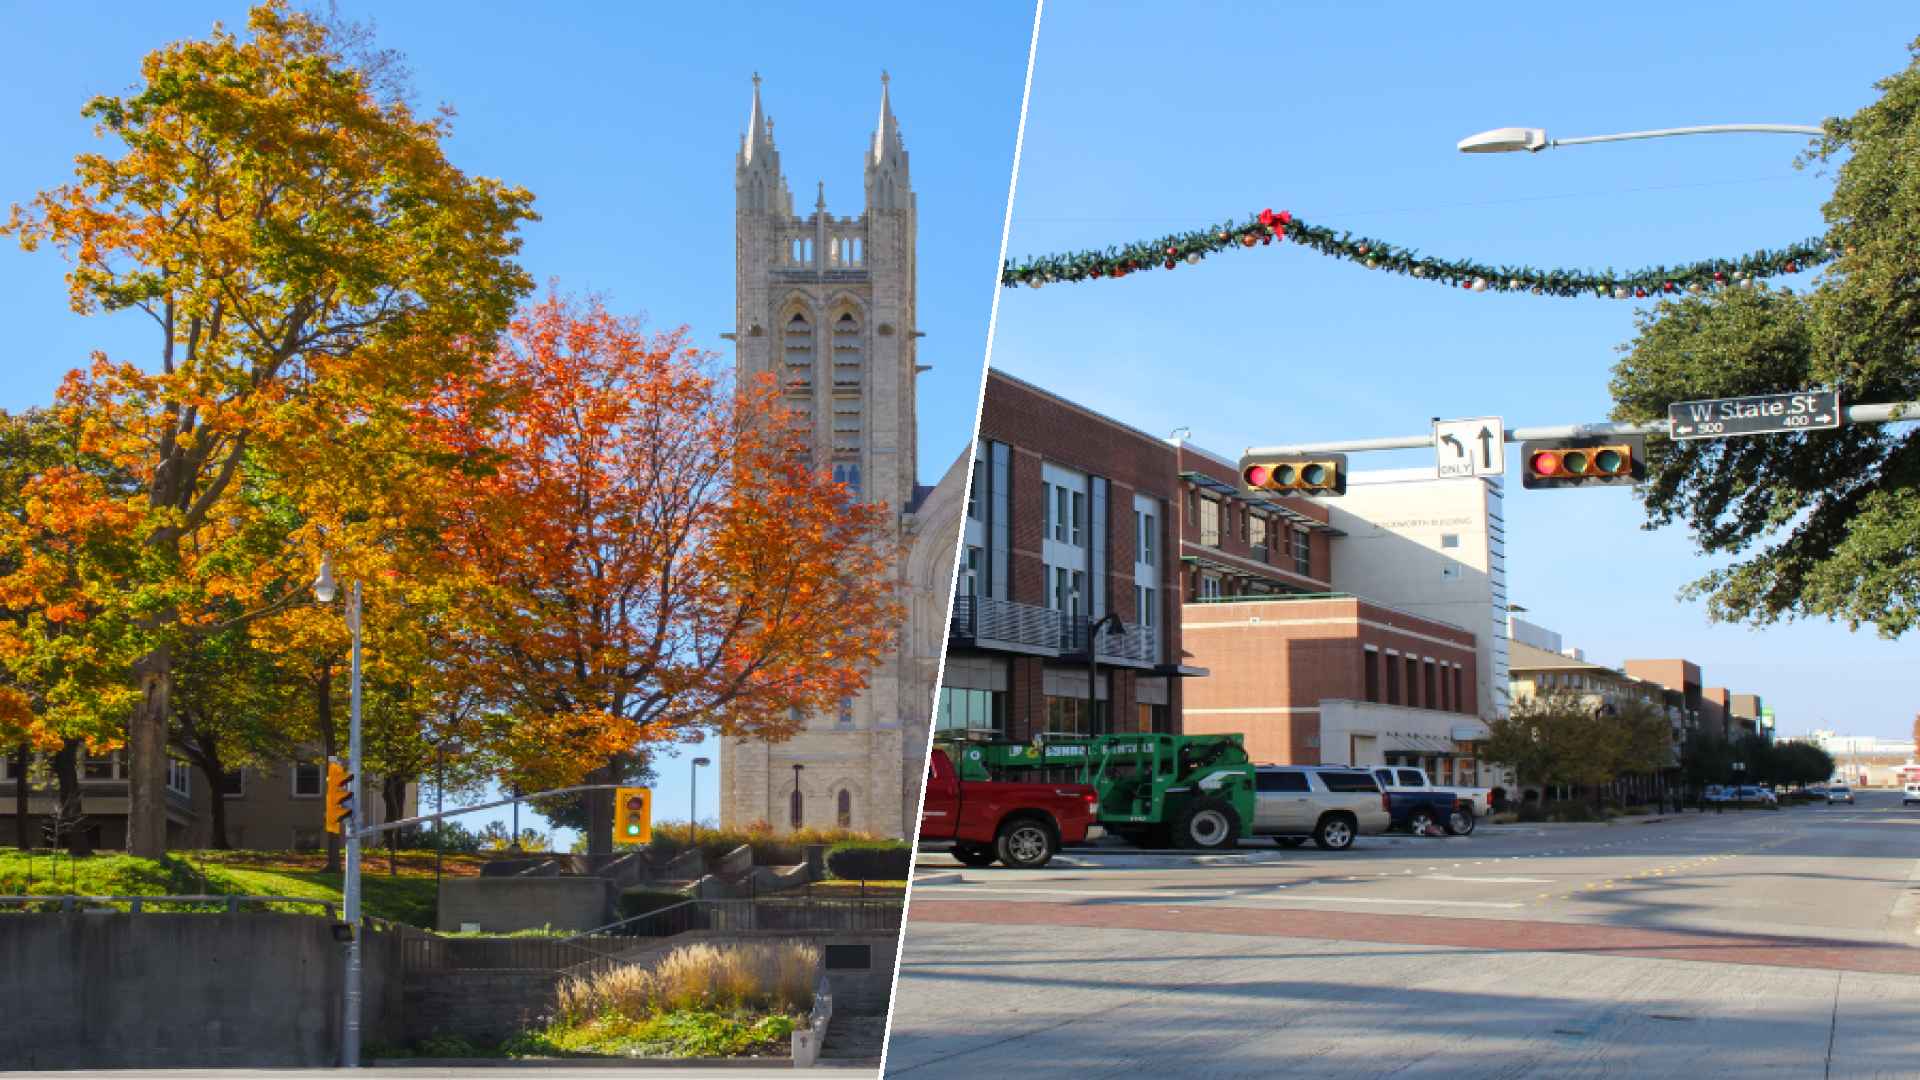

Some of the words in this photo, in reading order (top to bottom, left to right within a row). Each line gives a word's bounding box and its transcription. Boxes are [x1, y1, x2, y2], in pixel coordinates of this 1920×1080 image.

[1690, 404, 1711, 421] W
[1721, 399, 1784, 419] State
[1792, 395, 1816, 414] St
[1698, 422, 1724, 433] 500
[1784, 415, 1809, 426] 400
[1440, 464, 1471, 474] ONLY
